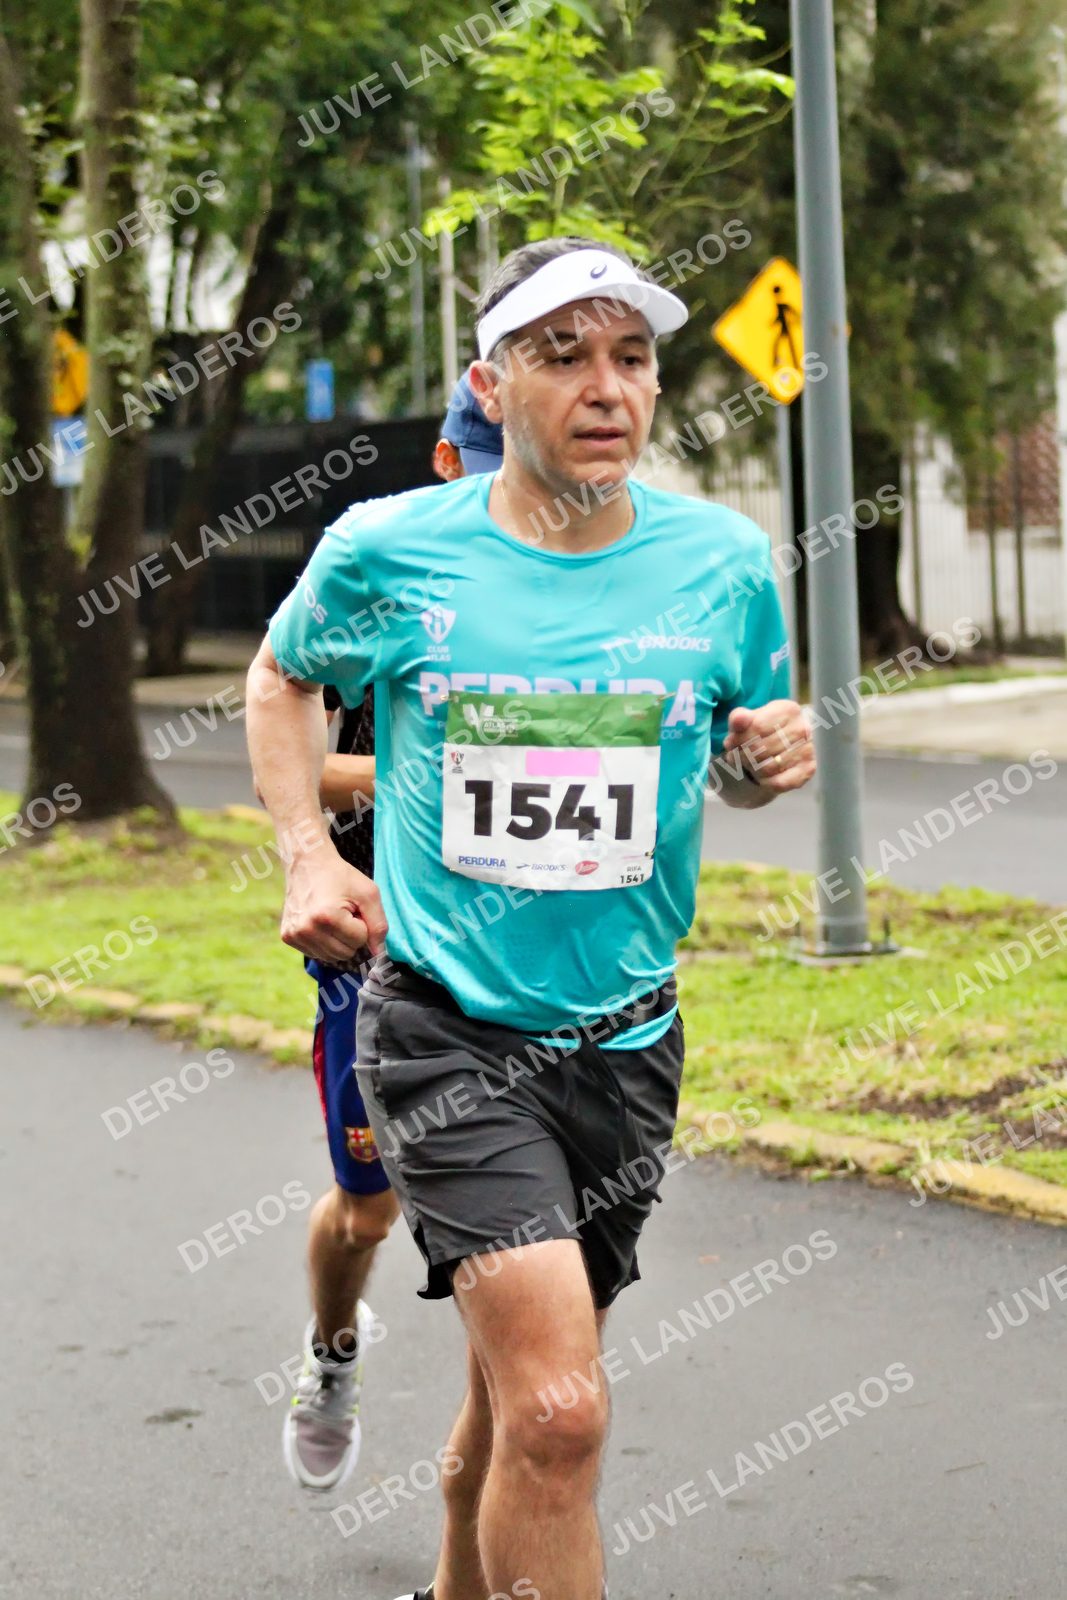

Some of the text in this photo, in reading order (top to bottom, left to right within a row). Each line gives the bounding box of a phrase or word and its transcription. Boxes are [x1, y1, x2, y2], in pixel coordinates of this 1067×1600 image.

[638, 635, 712, 652] BROOKS
[465, 780, 634, 841] 1541
[458, 855, 507, 868] PERDURA
[531, 863, 567, 871] BROOKS
[620, 874, 645, 884] 1541
